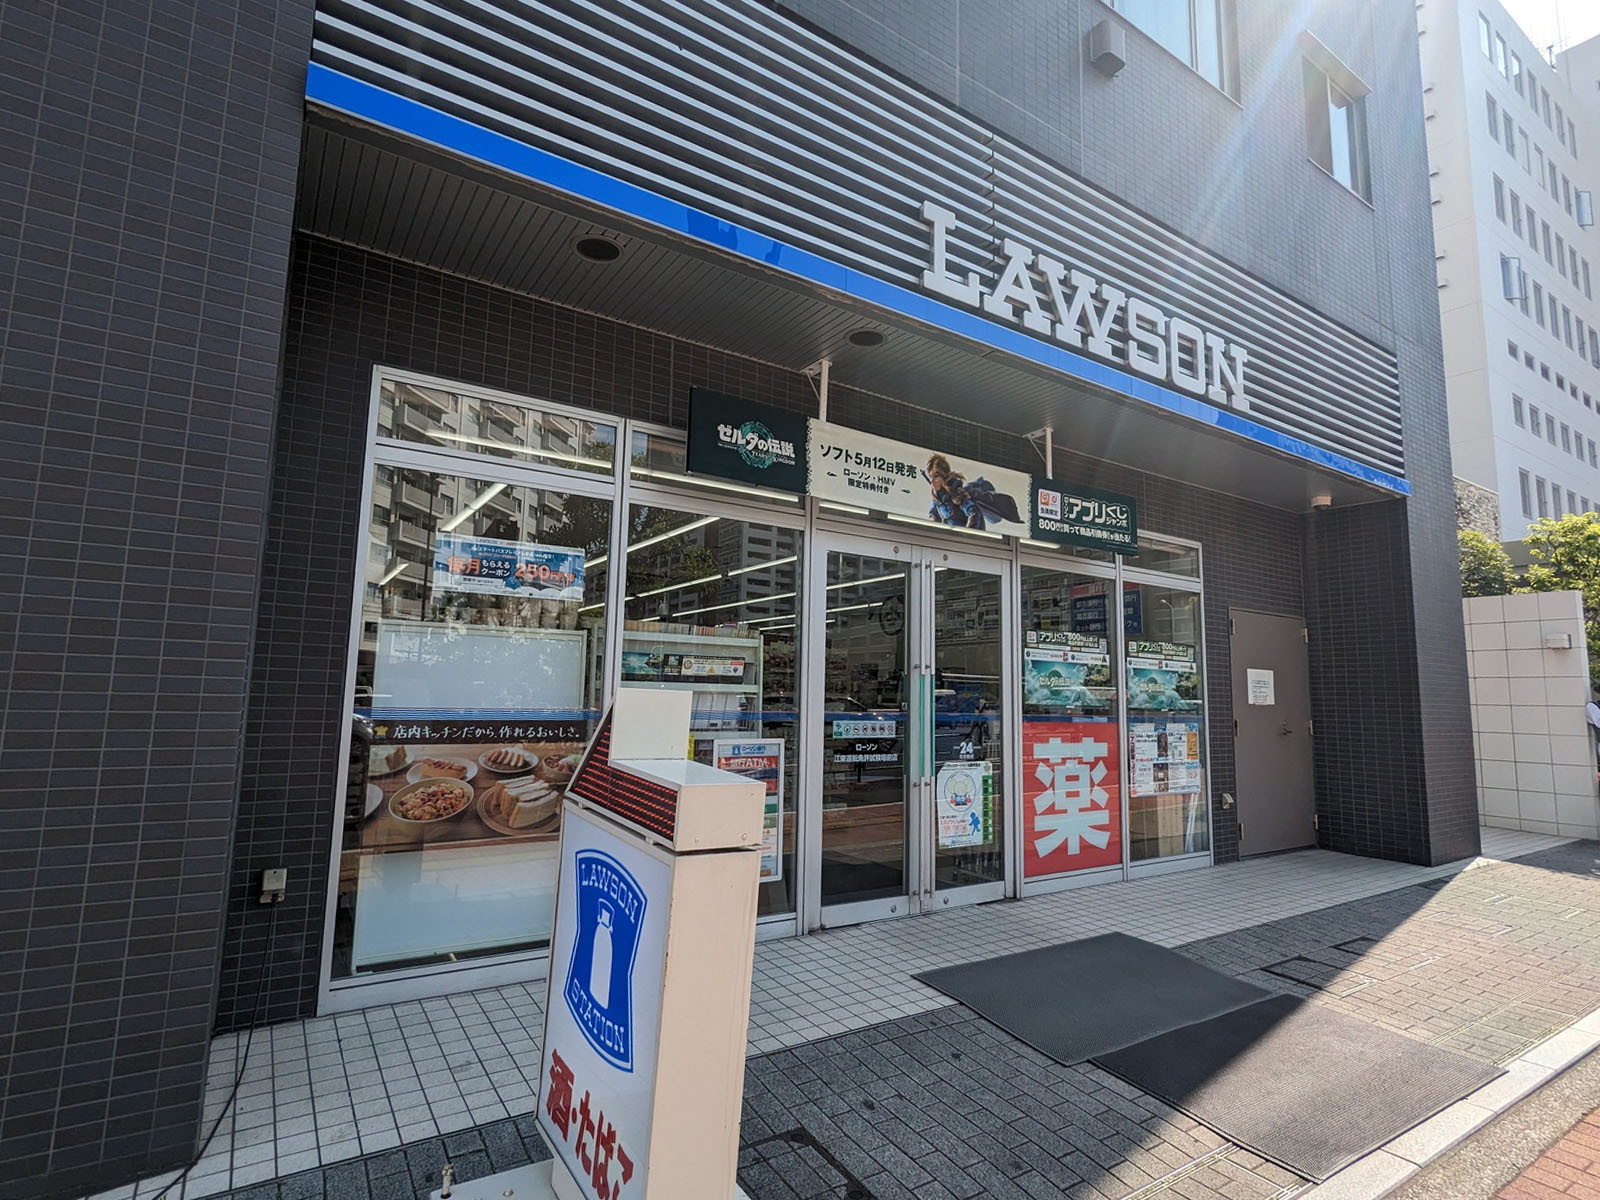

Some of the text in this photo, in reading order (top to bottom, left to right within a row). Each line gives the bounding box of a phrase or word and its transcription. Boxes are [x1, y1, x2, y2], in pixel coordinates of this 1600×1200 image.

[922, 200, 1250, 413] LAWSON
[717, 423, 796, 458] ゼルダの伝説
[820, 444, 918, 479] ソフト5月12日発売
[843, 468, 896, 486] ローソン・HMV
[847, 478, 890, 495] 限定特典付き
[1069, 498, 1128, 524] アプリくじ
[481, 567, 511, 577] クーポン
[482, 559, 511, 569] もらえる
[855, 743, 878, 751] ローソン
[959, 741, 974, 754] 24
[1032, 737, 1112, 859] 薬
[580, 862, 637, 924] LAWSON
[570, 977, 625, 1054] STATION
